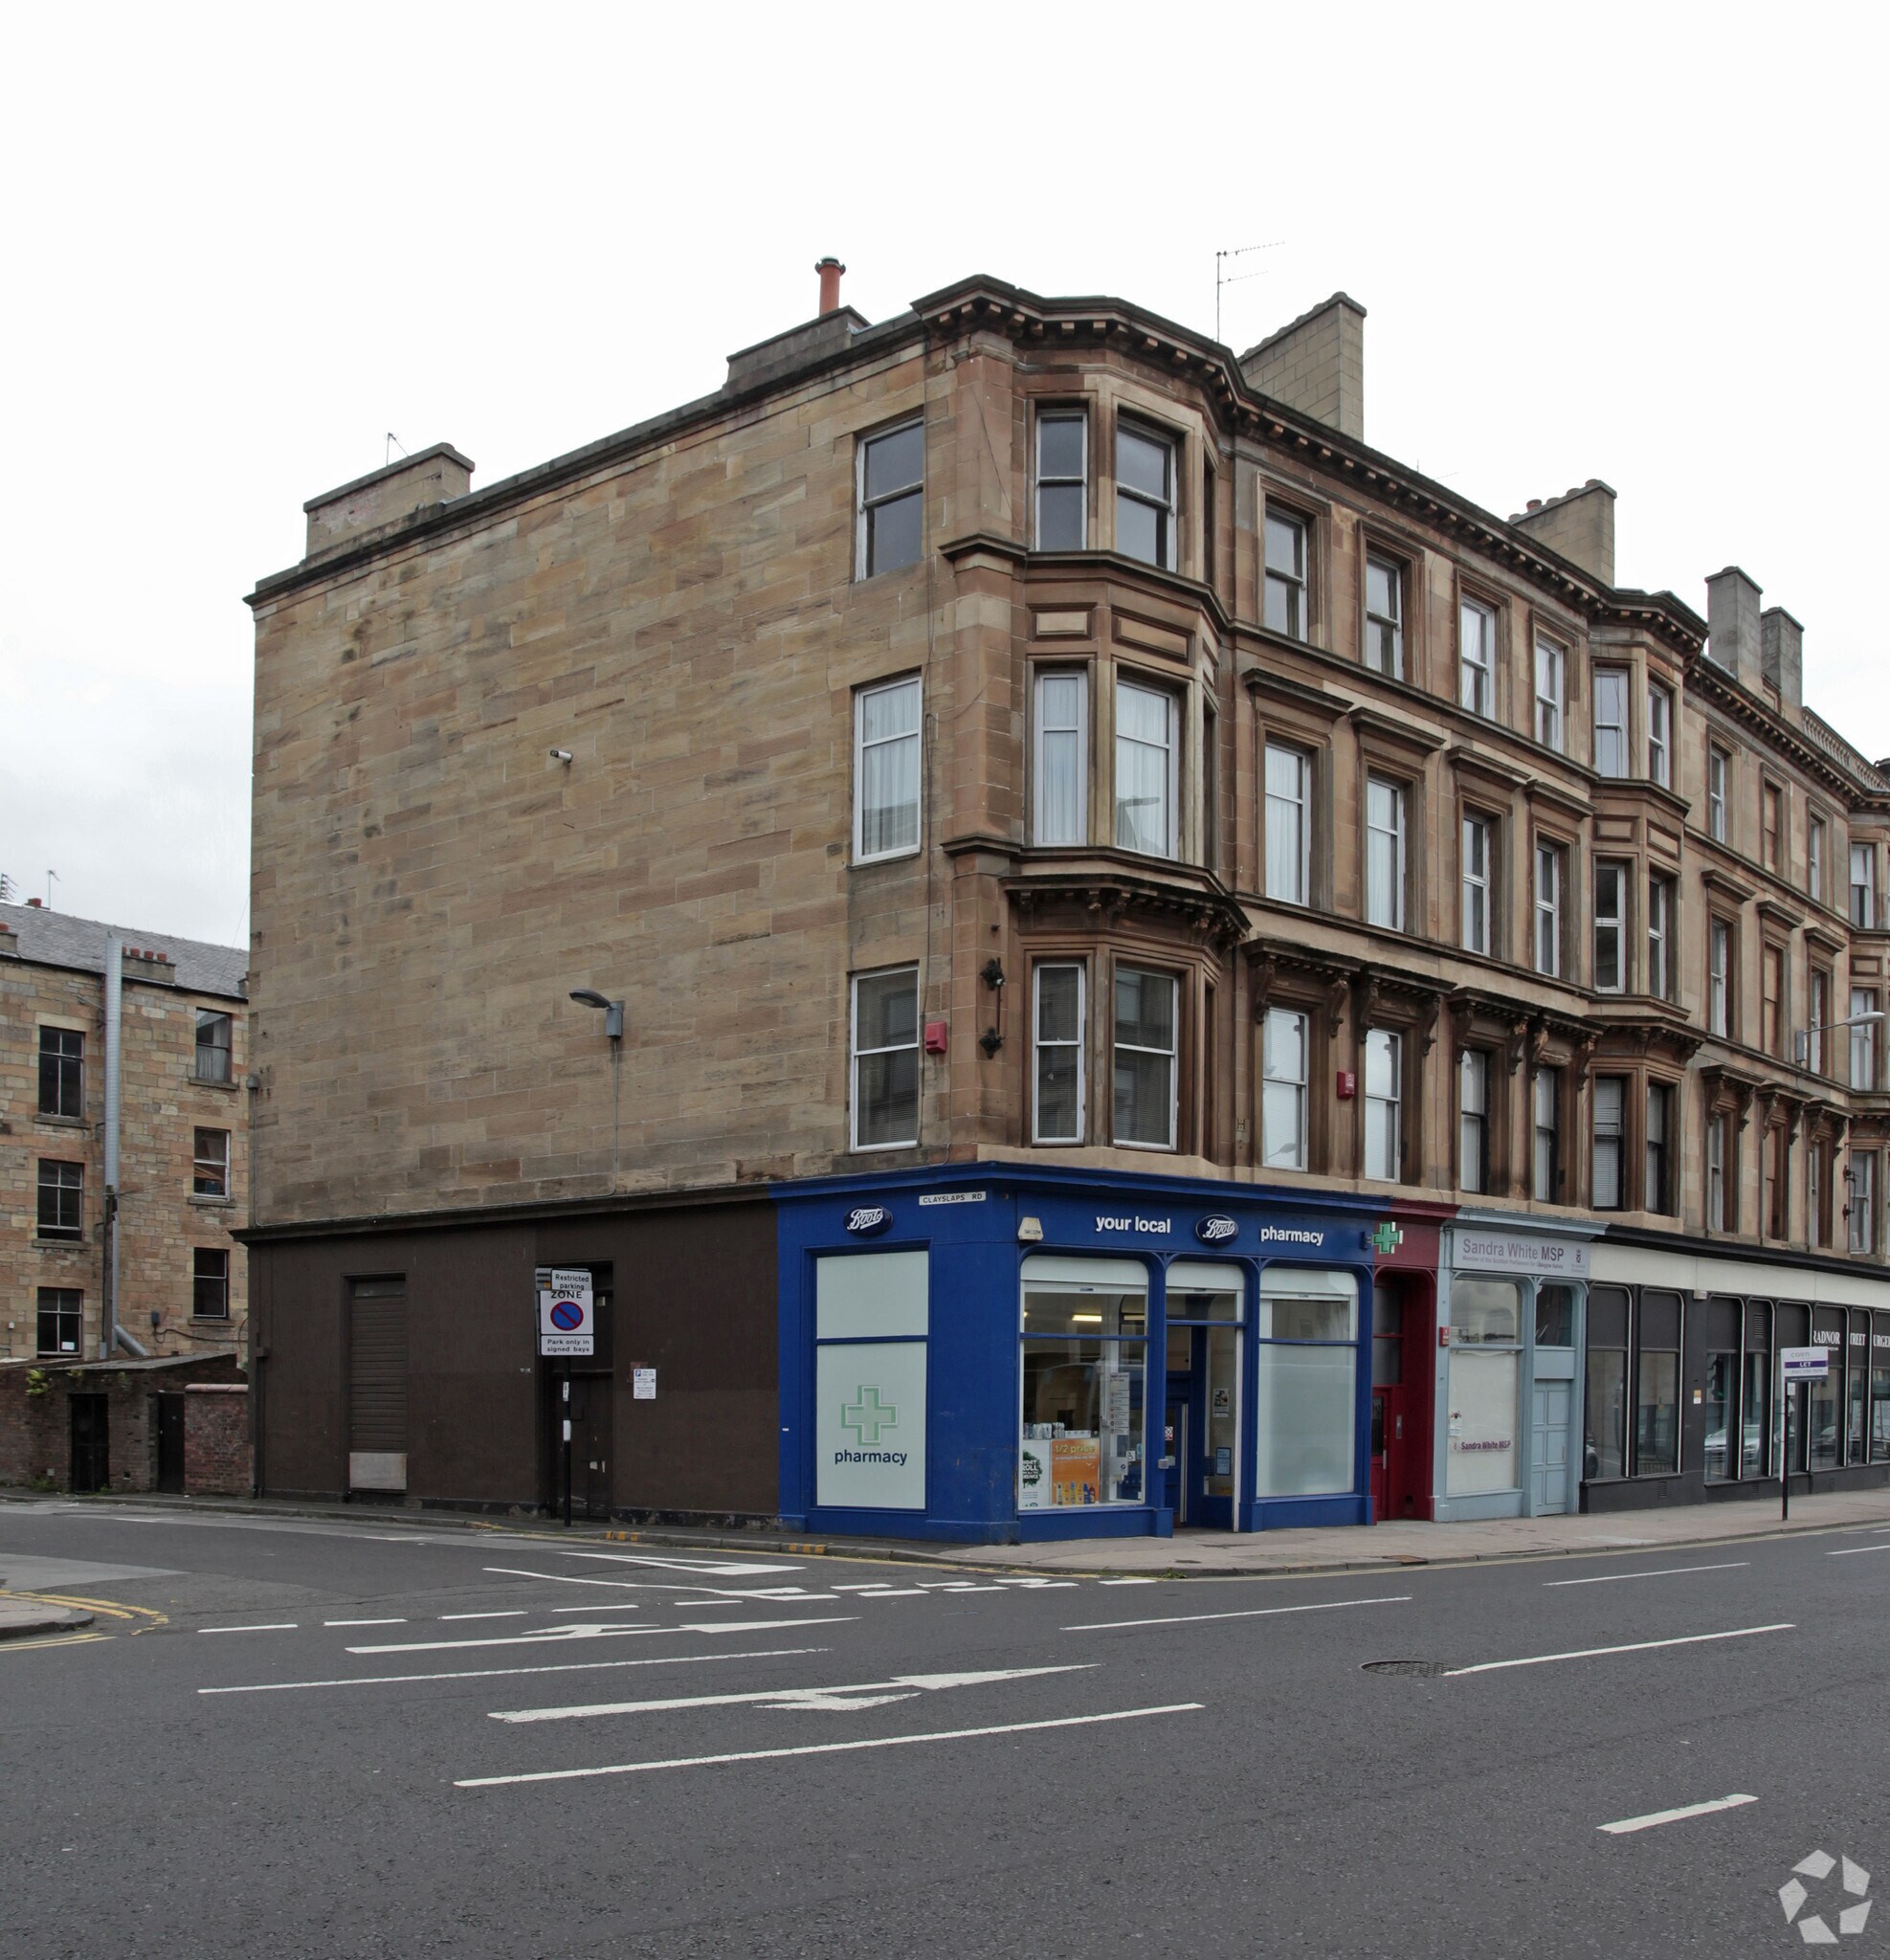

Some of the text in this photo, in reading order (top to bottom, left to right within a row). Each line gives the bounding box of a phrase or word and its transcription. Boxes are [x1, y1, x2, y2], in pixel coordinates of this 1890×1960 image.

[923, 1194, 966, 1204] CLAYSLAPS
[846, 1207, 885, 1231] Boots
[1096, 1215, 1171, 1234] your local
[1202, 1218, 1237, 1239] Boots
[1260, 1226, 1323, 1246] pharmacy
[1462, 1237, 1565, 1261] Sandra White MSP
[555, 1273, 589, 1282] Restricted
[1070, 1444, 1096, 1455] price
[1461, 1441, 1481, 1451] Sandra
[1481, 1440, 1499, 1450] White
[834, 1449, 907, 1466] pharmacy
